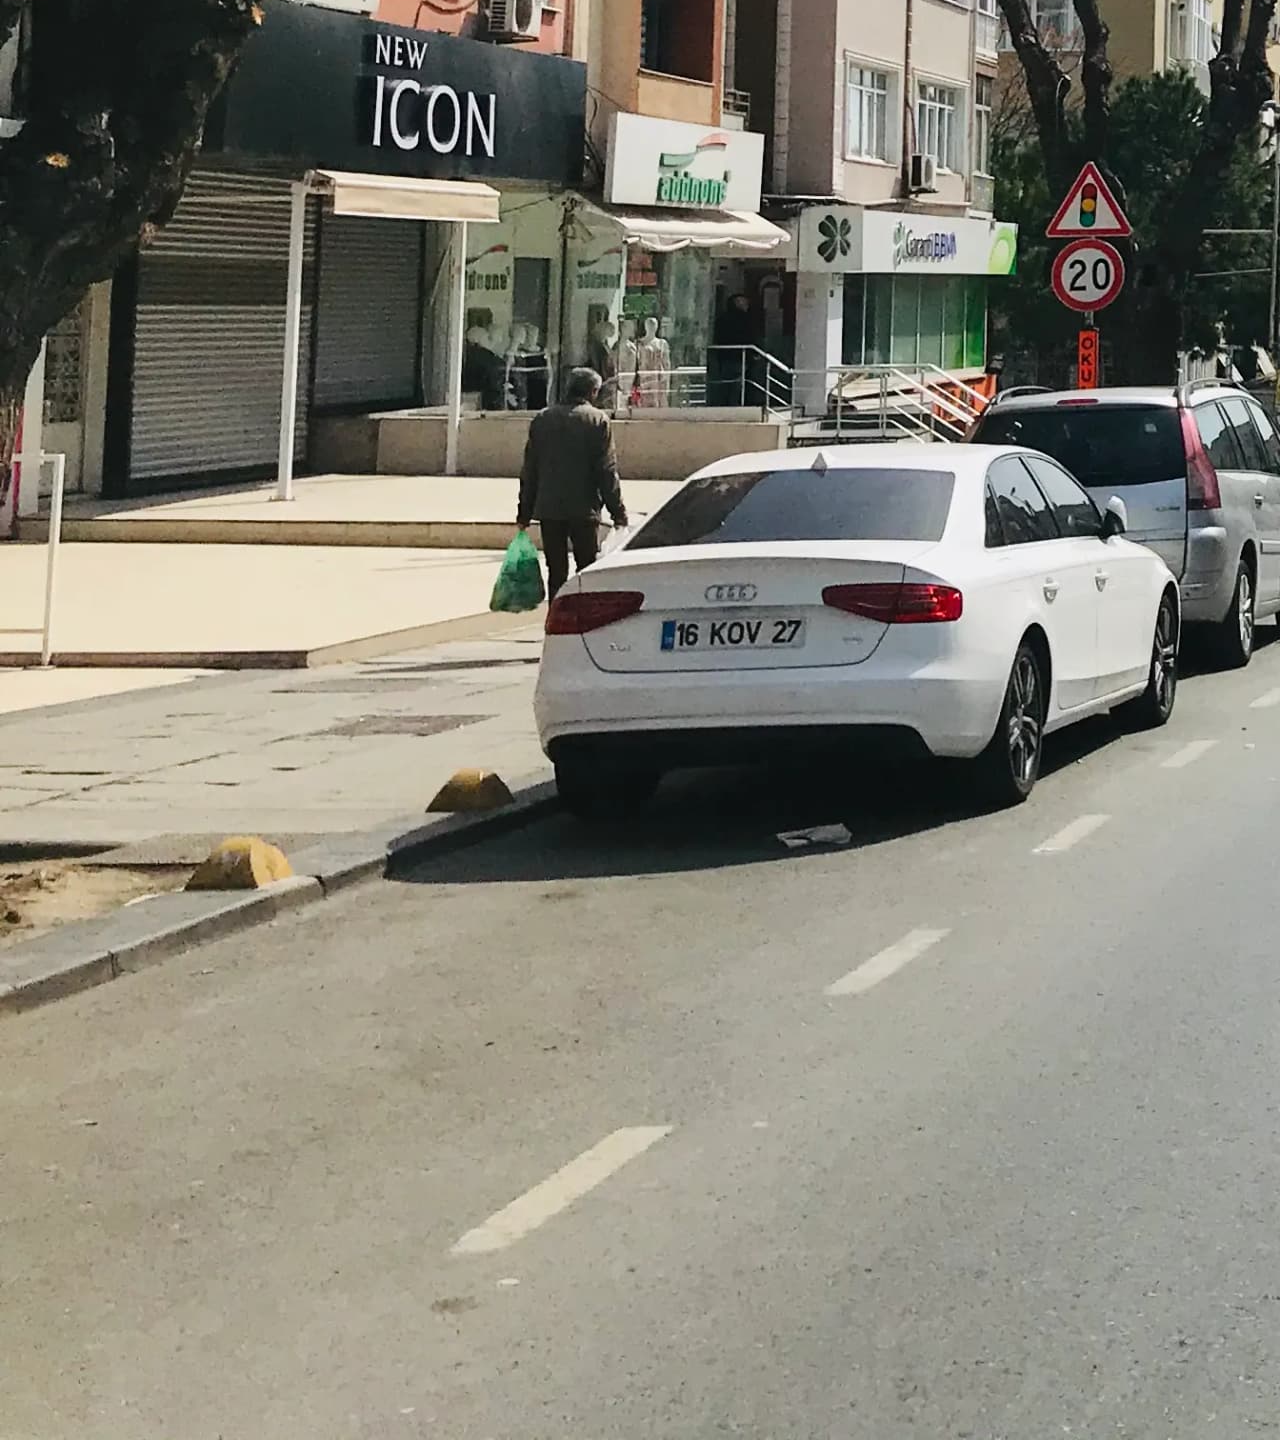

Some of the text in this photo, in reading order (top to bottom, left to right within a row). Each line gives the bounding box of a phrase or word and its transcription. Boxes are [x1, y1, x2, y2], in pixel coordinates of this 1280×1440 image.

[375, 34, 429, 70] NEW
[372, 75, 497, 158] ICON
[1068, 258, 1111, 292] 20
[676, 619, 801, 647] 16 KOV 27
